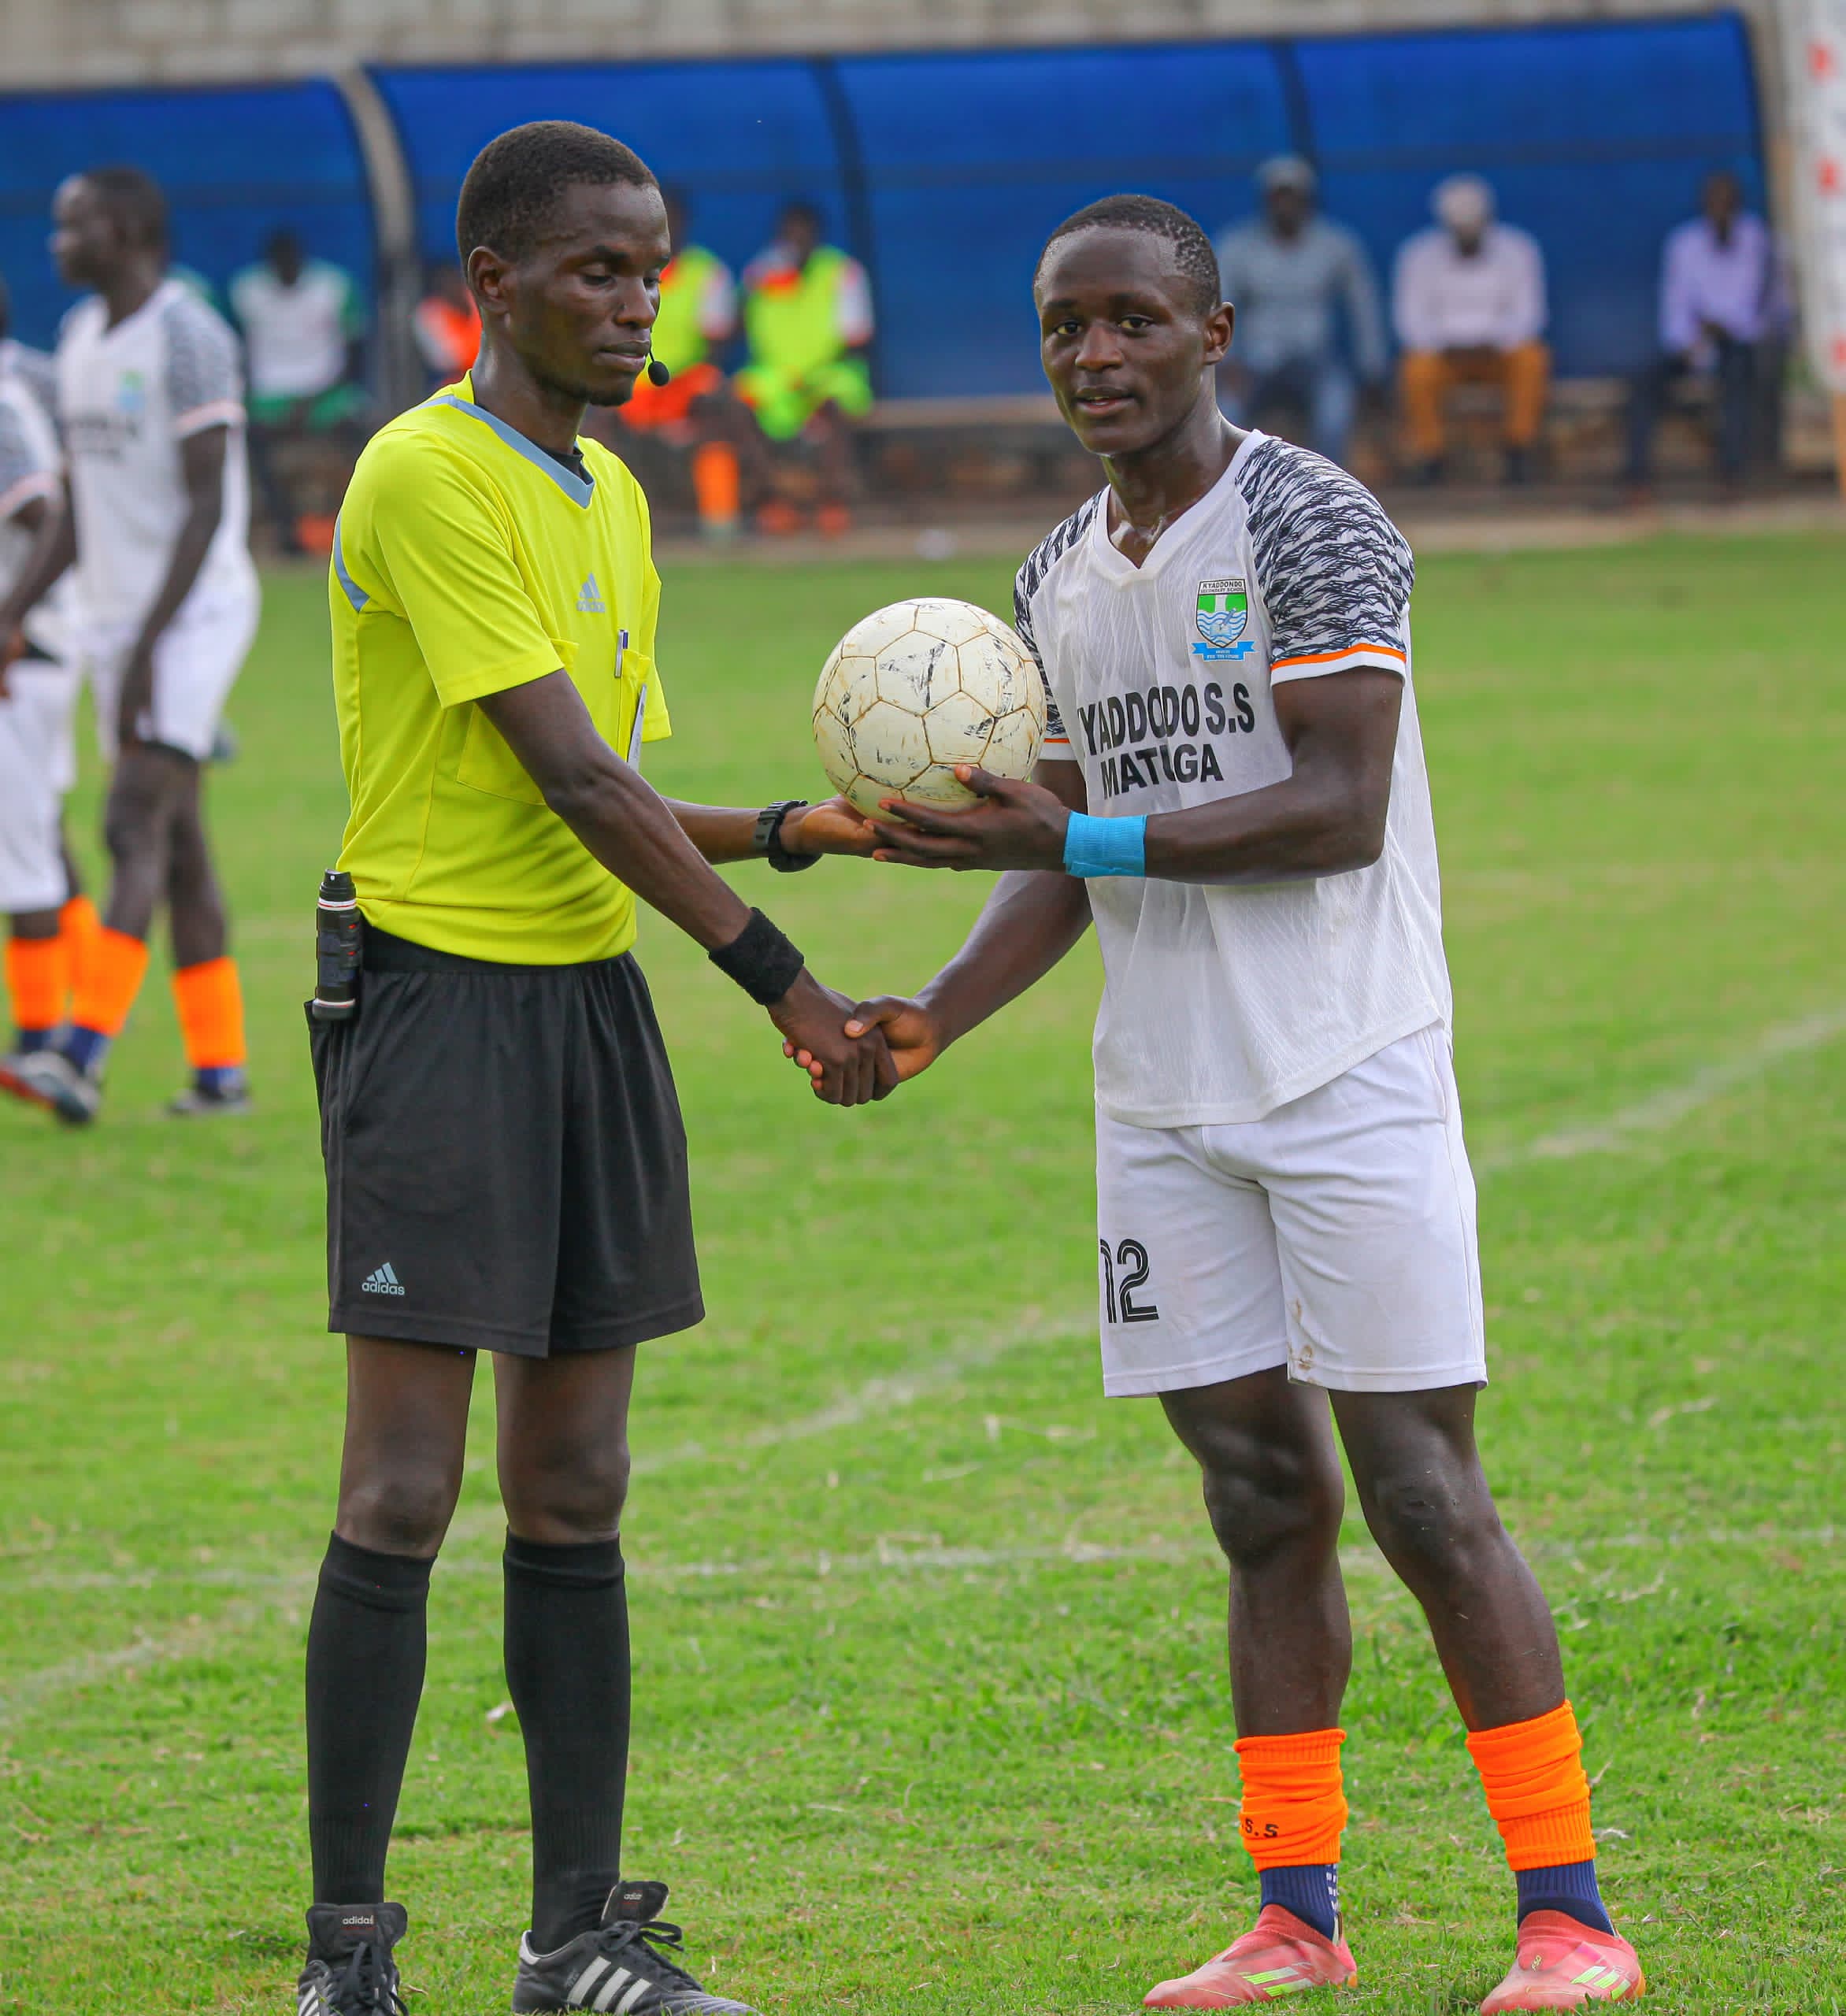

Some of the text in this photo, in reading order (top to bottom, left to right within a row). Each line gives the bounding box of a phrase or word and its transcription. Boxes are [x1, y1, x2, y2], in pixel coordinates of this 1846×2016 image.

[1203, 682, 1255, 735] S.S
[361, 1280, 405, 1295] adidas
[1099, 1238, 1159, 1324] 12
